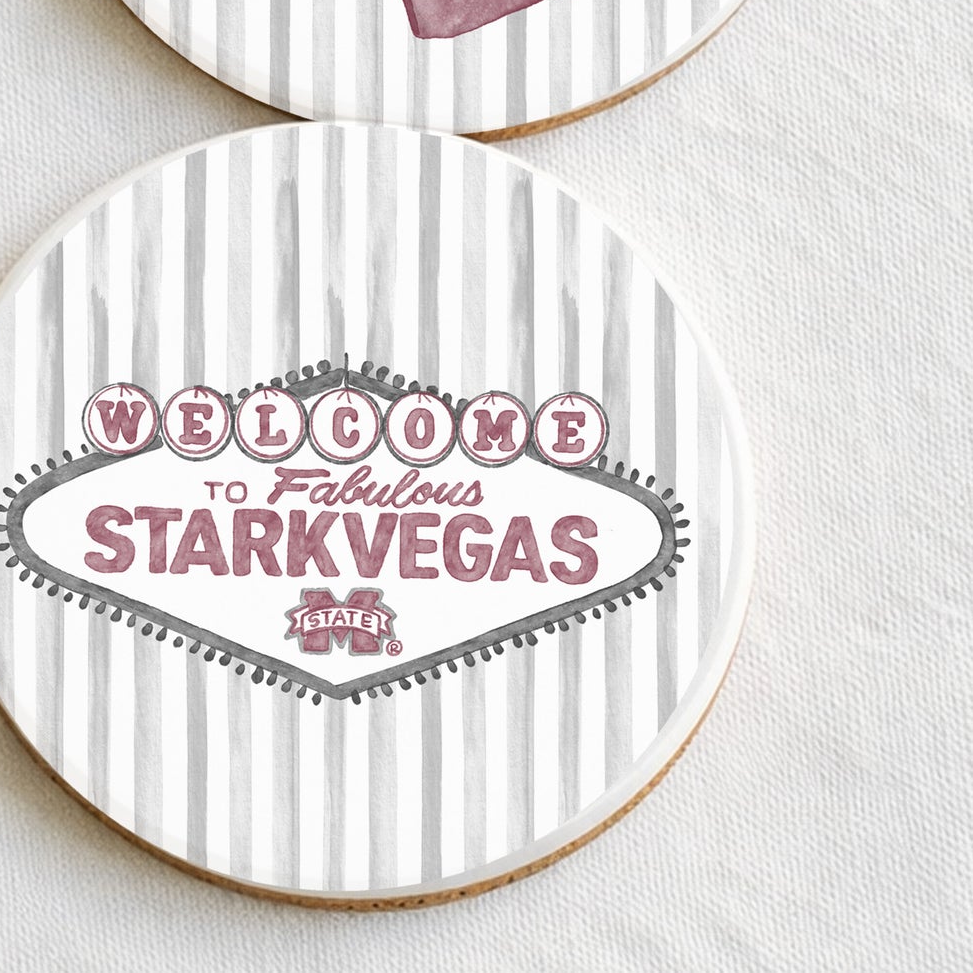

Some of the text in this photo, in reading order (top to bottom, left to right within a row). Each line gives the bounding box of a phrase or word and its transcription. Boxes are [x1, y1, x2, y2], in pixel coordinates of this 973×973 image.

[96, 399, 587, 454] WELCOME
[204, 464, 485, 509] TO Fabulous
[83, 505, 599, 585] STARKVEGAS
[308, 609, 373, 628] STATE
